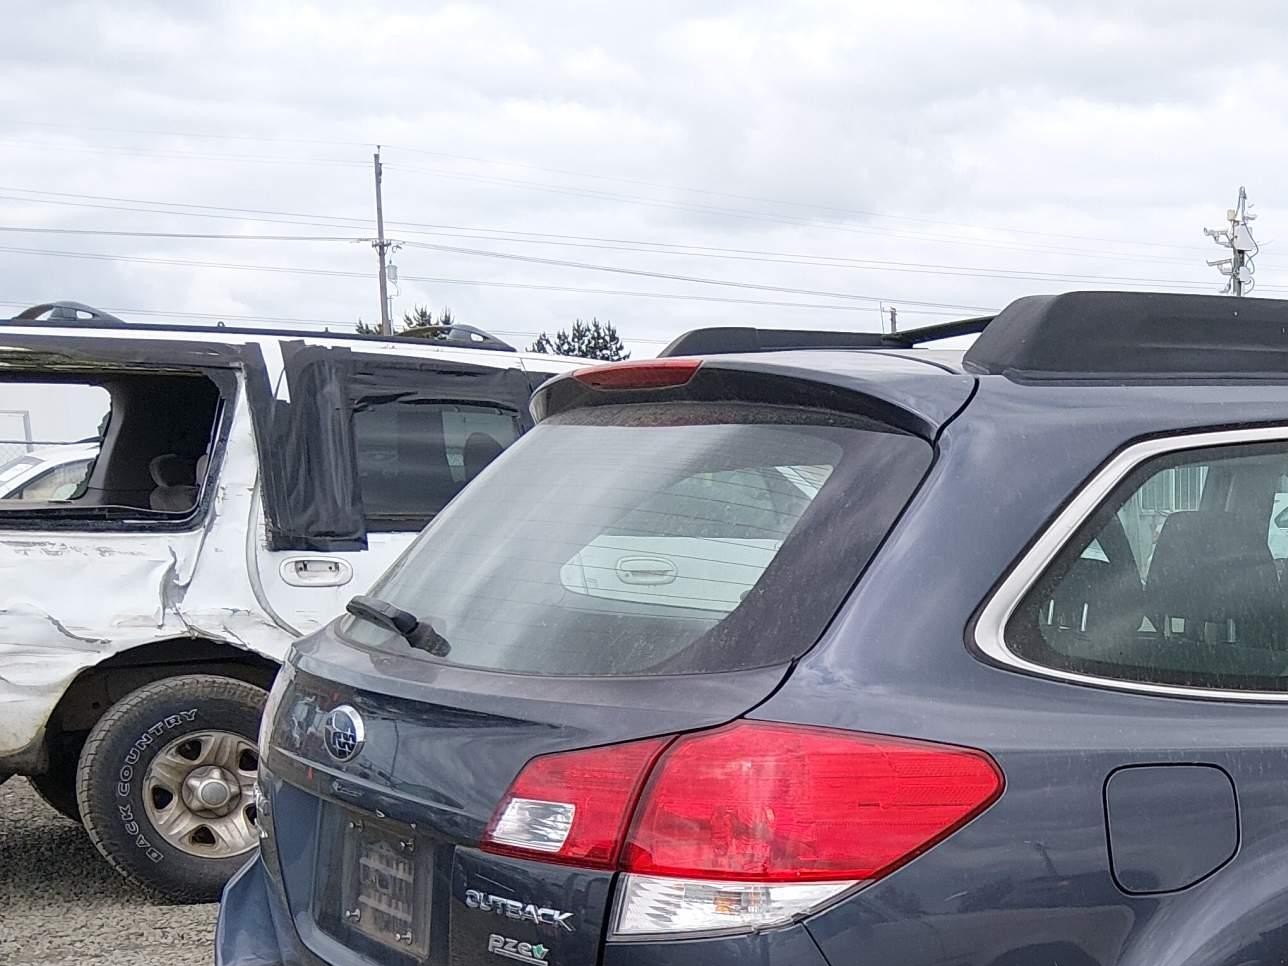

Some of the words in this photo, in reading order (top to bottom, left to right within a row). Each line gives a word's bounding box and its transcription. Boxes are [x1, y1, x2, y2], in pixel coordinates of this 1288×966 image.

[118, 708, 198, 797] COUNTRY
[118, 803, 164, 863] BACK
[465, 889, 576, 933] OUTBACK
